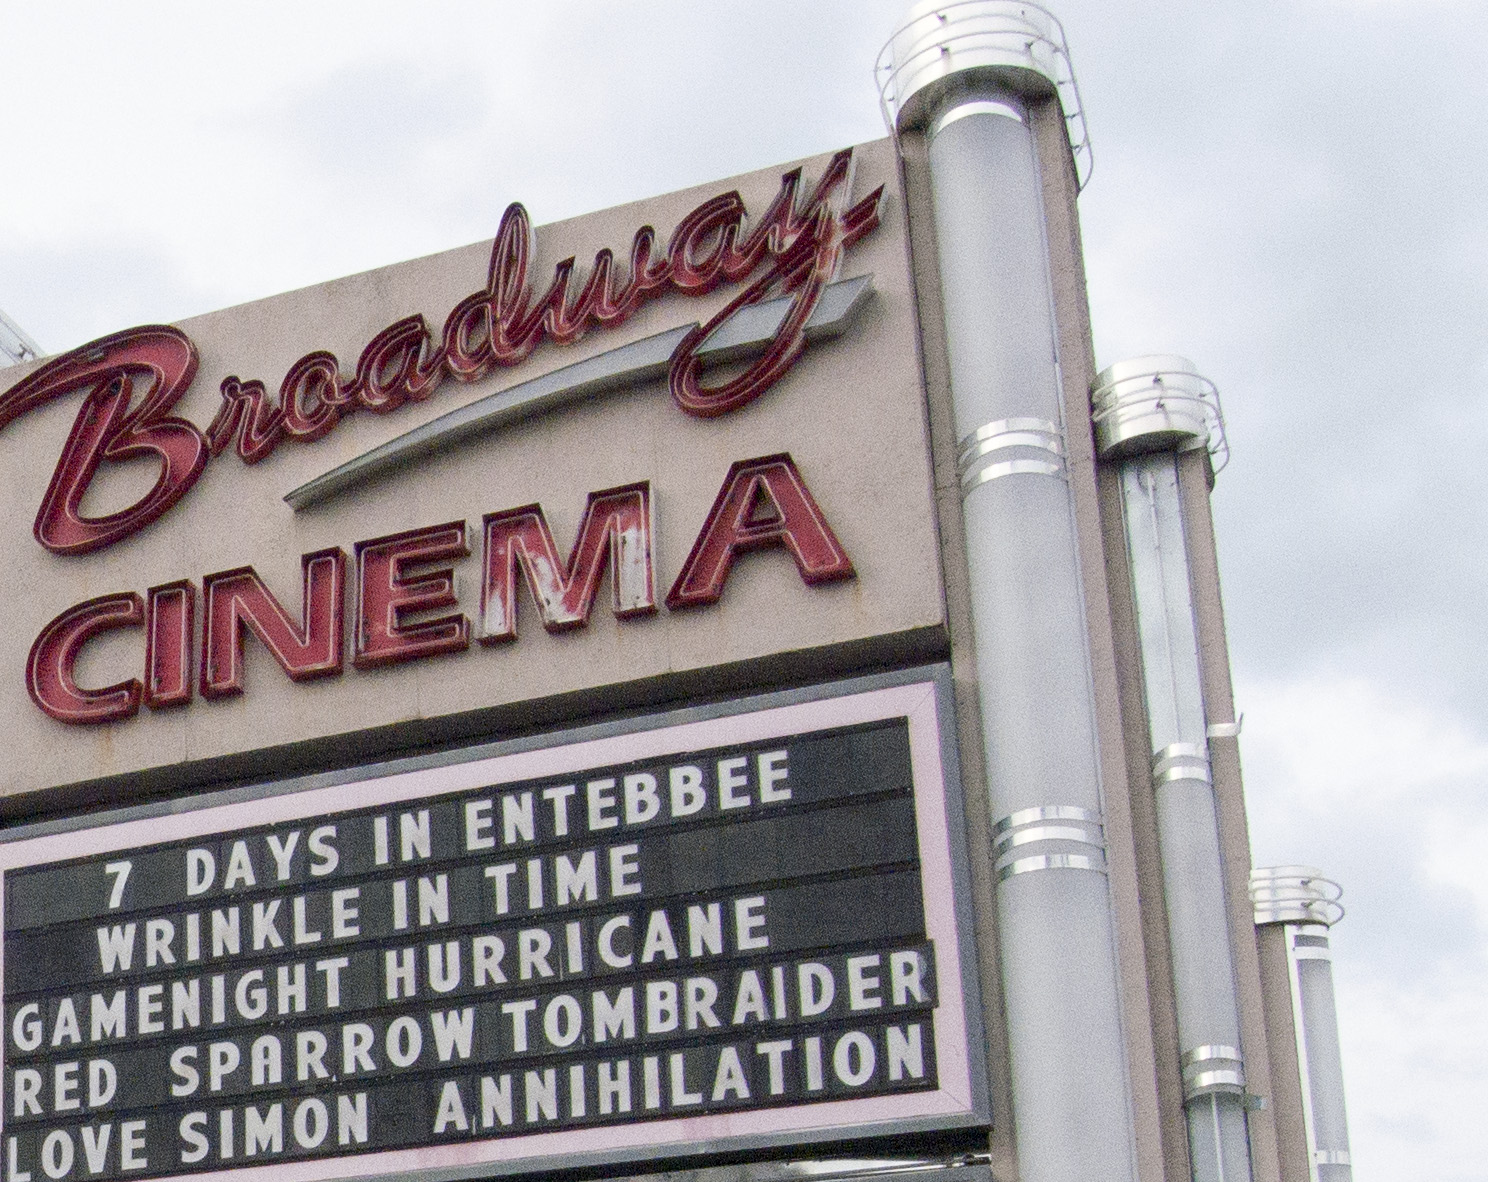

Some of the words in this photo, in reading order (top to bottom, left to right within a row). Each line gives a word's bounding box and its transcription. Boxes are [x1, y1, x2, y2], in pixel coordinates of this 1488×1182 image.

[26, 451, 858, 724] CINEMA
[96, 887, 360, 974] WRINKLE
[392, 873, 450, 930] IN
[484, 843, 642, 915] TIME
[104, 860, 133, 910] 7
[186, 825, 340, 897] DAYS
[373, 809, 432, 866] IN
[464, 749, 792, 851] ENTEBBEE
[11, 956, 349, 1052] GAMENIGHT
[385, 895, 769, 1000] HURRICANE
[13, 1058, 118, 1117] RED
[169, 1007, 475, 1097] SPARROW
[501, 950, 927, 1053] TOMBRAIDER
[179, 1092, 368, 1164] SIMON
[433, 1023, 924, 1134] ANNIHILATION
